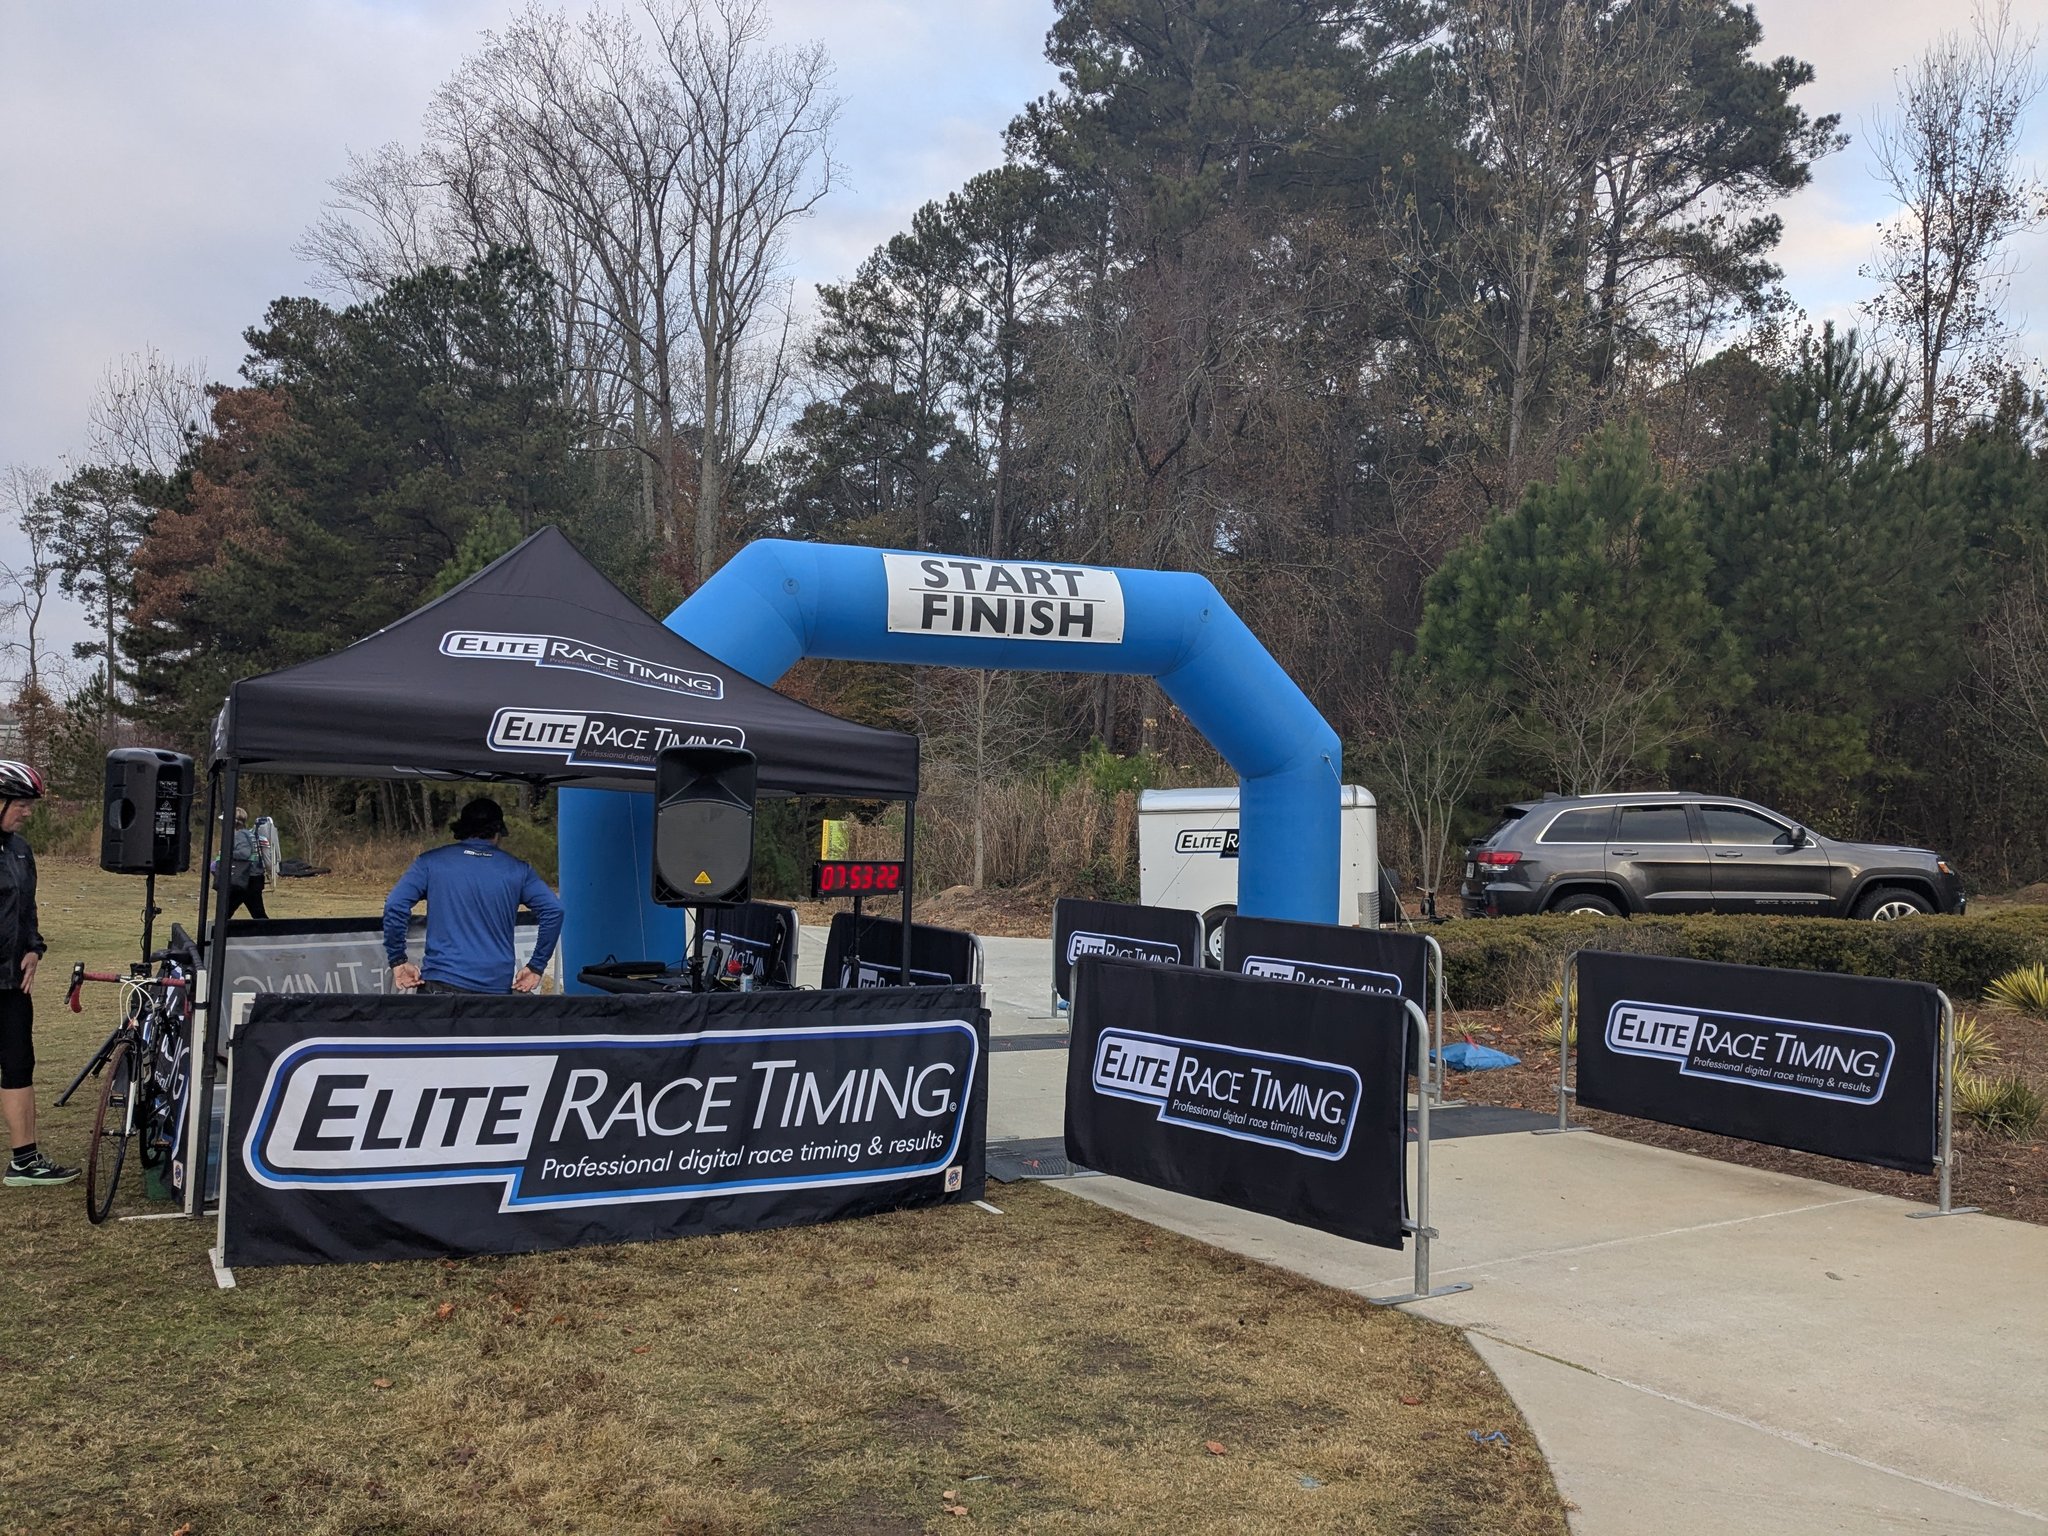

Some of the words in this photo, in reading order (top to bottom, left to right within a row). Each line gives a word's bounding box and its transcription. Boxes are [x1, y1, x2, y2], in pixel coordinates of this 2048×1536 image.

[920, 559, 1084, 597] START
[920, 593, 1094, 638] FINISH
[456, 637, 540, 655] ELITE
[550, 642, 619, 670] RACE
[501, 716, 579, 744] ELITE
[583, 720, 650, 750] RACE
[1181, 834, 1222, 848] ELITE
[1617, 1013, 1690, 1048] ELITE
[1697, 1022, 1769, 1061] RACE
[1774, 1032, 1880, 1078] TIMING
[1100, 1043, 1170, 1088] ELITE
[1176, 1056, 1244, 1104] RACE
[1250, 1067, 1346, 1124] TIMING
[1693, 1056, 1743, 1073] Professional
[1744, 1064, 1772, 1078] digital
[1773, 1070, 1794, 1081] race
[1796, 1072, 1824, 1088] timing
[1826, 1076, 1835, 1087] &
[1838, 1078, 1871, 1093] results
[292, 1073, 531, 1152] ELITE
[549, 1068, 738, 1143] RACE
[1172, 1099, 1222, 1119] Professional
[1222, 1109, 1246, 1126] digital
[1248, 1116, 1268, 1129] race
[1270, 1119, 1298, 1138] timing
[1305, 1127, 1338, 1145] results
[541, 1150, 674, 1180] Professional
[678, 1145, 743, 1175] digital
[748, 1144, 794, 1165] race
[800, 1139, 861, 1164] timing
[867, 1135, 883, 1156] &
[889, 1130, 944, 1154] results
